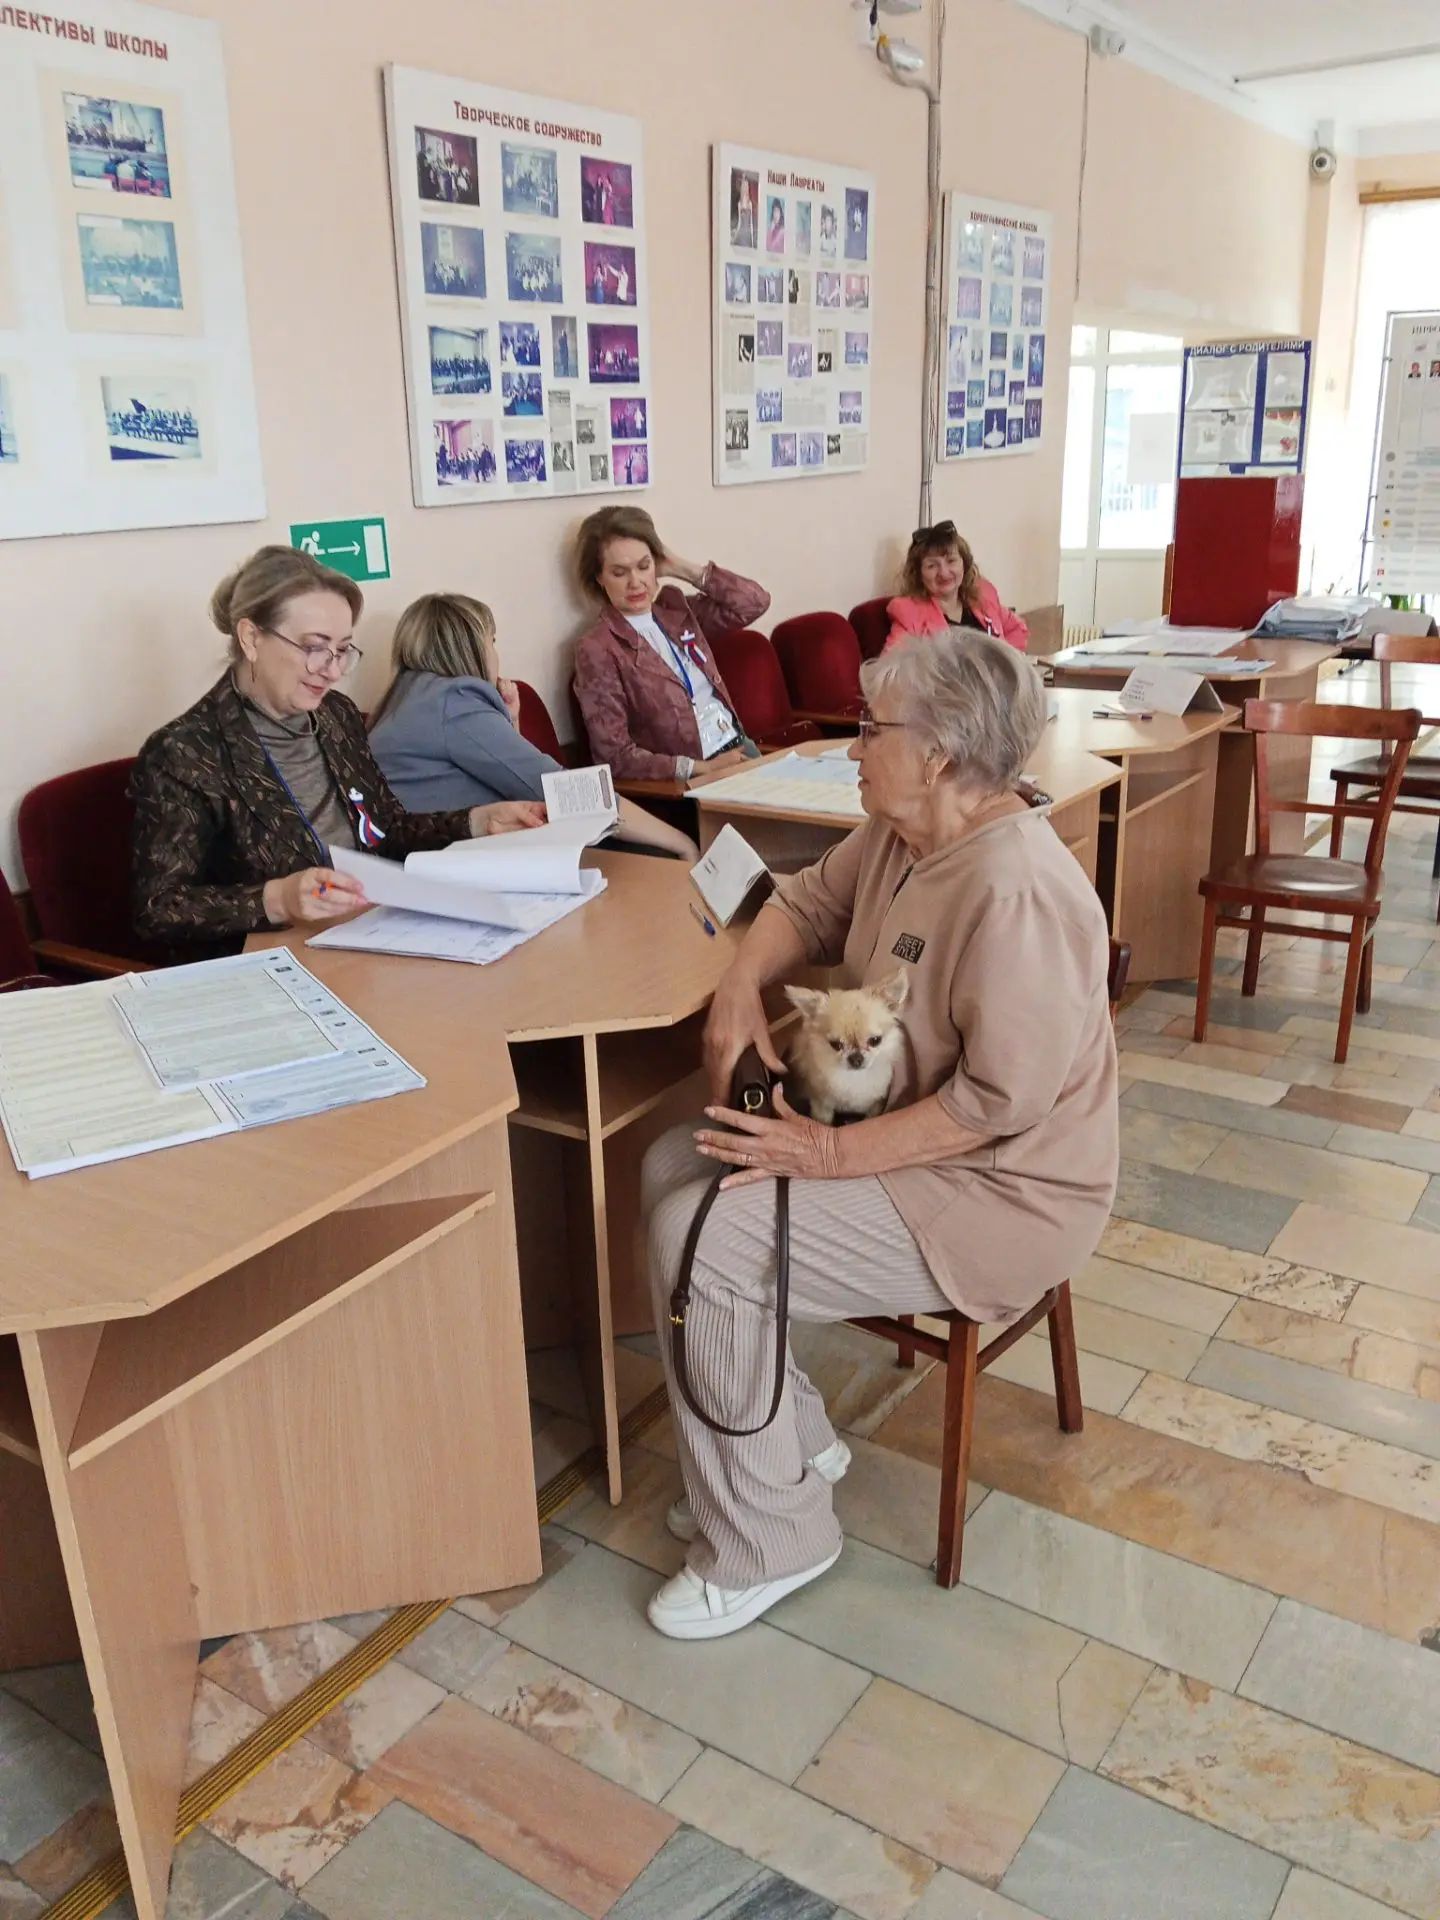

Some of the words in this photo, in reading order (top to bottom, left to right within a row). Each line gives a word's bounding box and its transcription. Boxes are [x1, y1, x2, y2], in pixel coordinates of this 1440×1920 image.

[104, 29, 168, 61] ШКОЛЫ
[534, 120, 602, 146] СОДРУЖЕСТВО
[1189, 344, 1227, 356] ДИАЛОГ
[1230, 345, 1237, 353] С
[1238, 340, 1305, 353] РОДИТЕЛЯМИ
